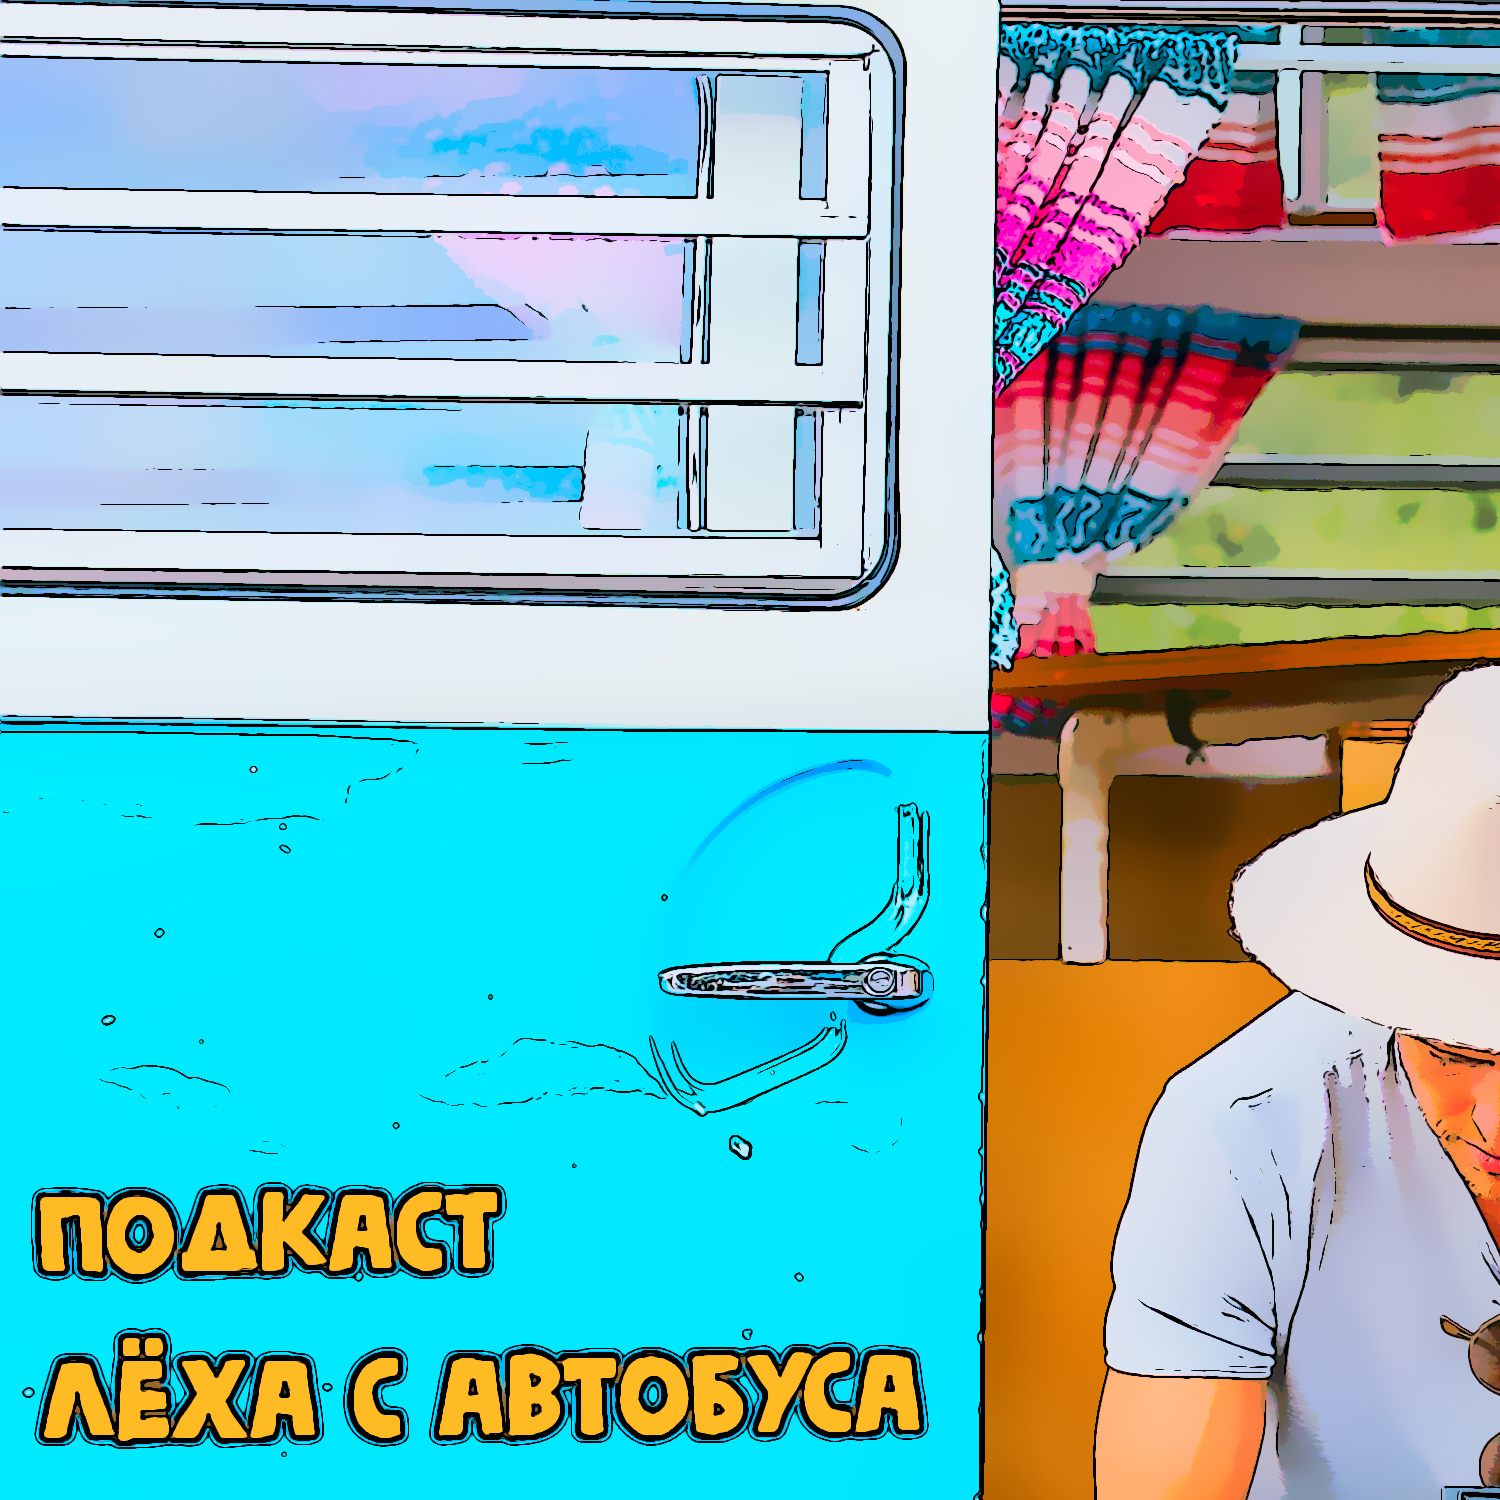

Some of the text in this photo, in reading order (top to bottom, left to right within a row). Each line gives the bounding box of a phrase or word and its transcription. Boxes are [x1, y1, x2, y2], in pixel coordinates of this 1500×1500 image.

[35, 1186, 504, 1279] ПОДКАСТ
[38, 1332, 926, 1447] ЛЁХА С АВТОБУСА
